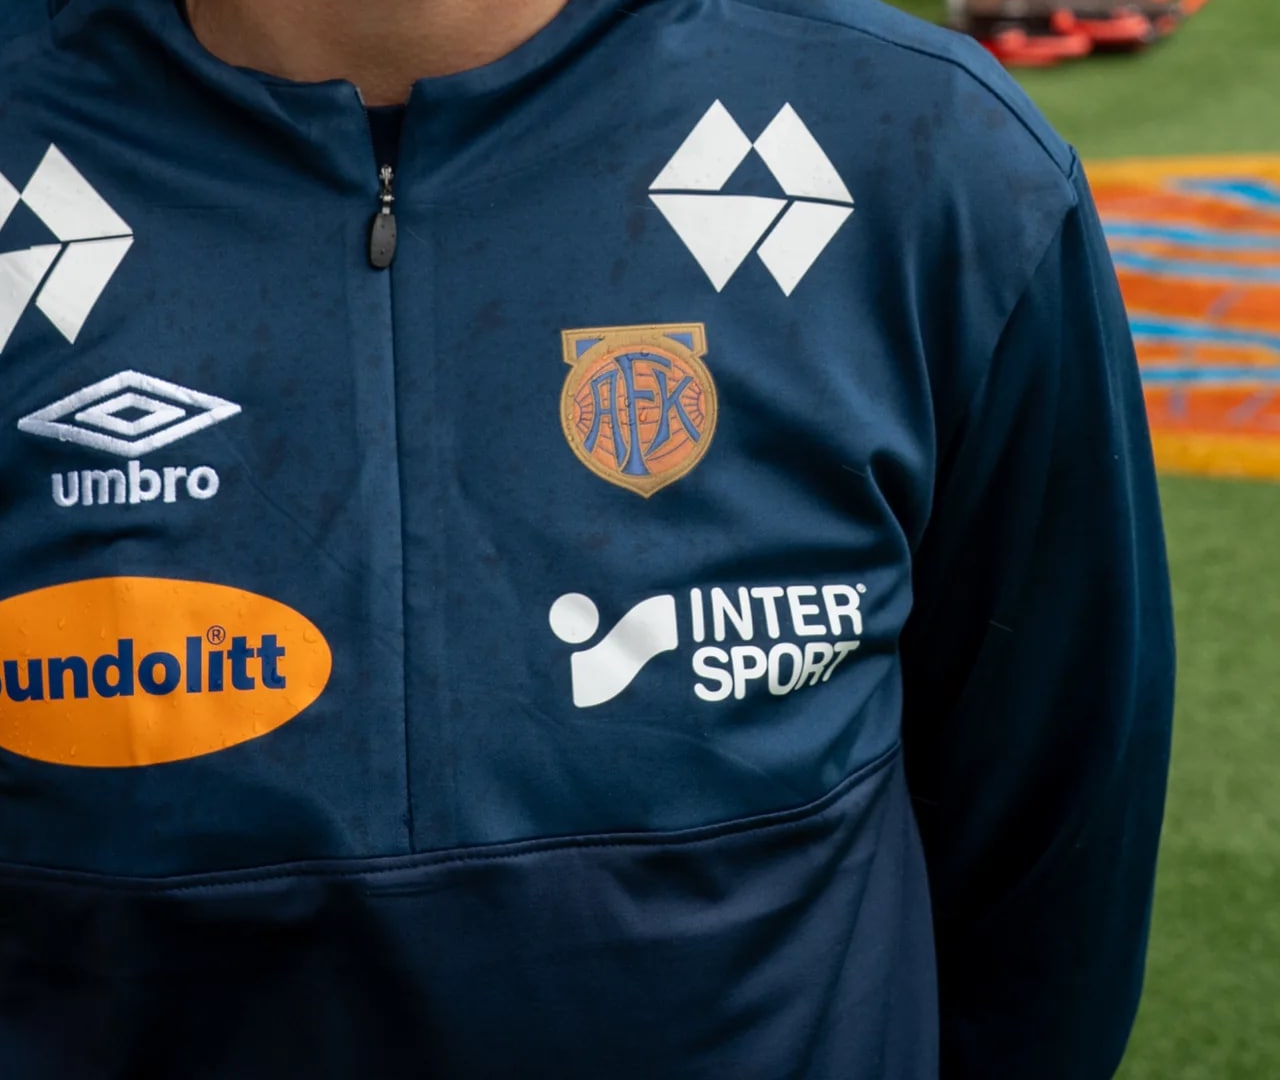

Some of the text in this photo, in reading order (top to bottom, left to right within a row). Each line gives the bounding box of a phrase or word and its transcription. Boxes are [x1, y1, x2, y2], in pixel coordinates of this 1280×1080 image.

[583, 352, 701, 476] AFK
[51, 460, 219, 507] umbro
[690, 584, 864, 643] INTER
[692, 640, 860, 702] SPORT
